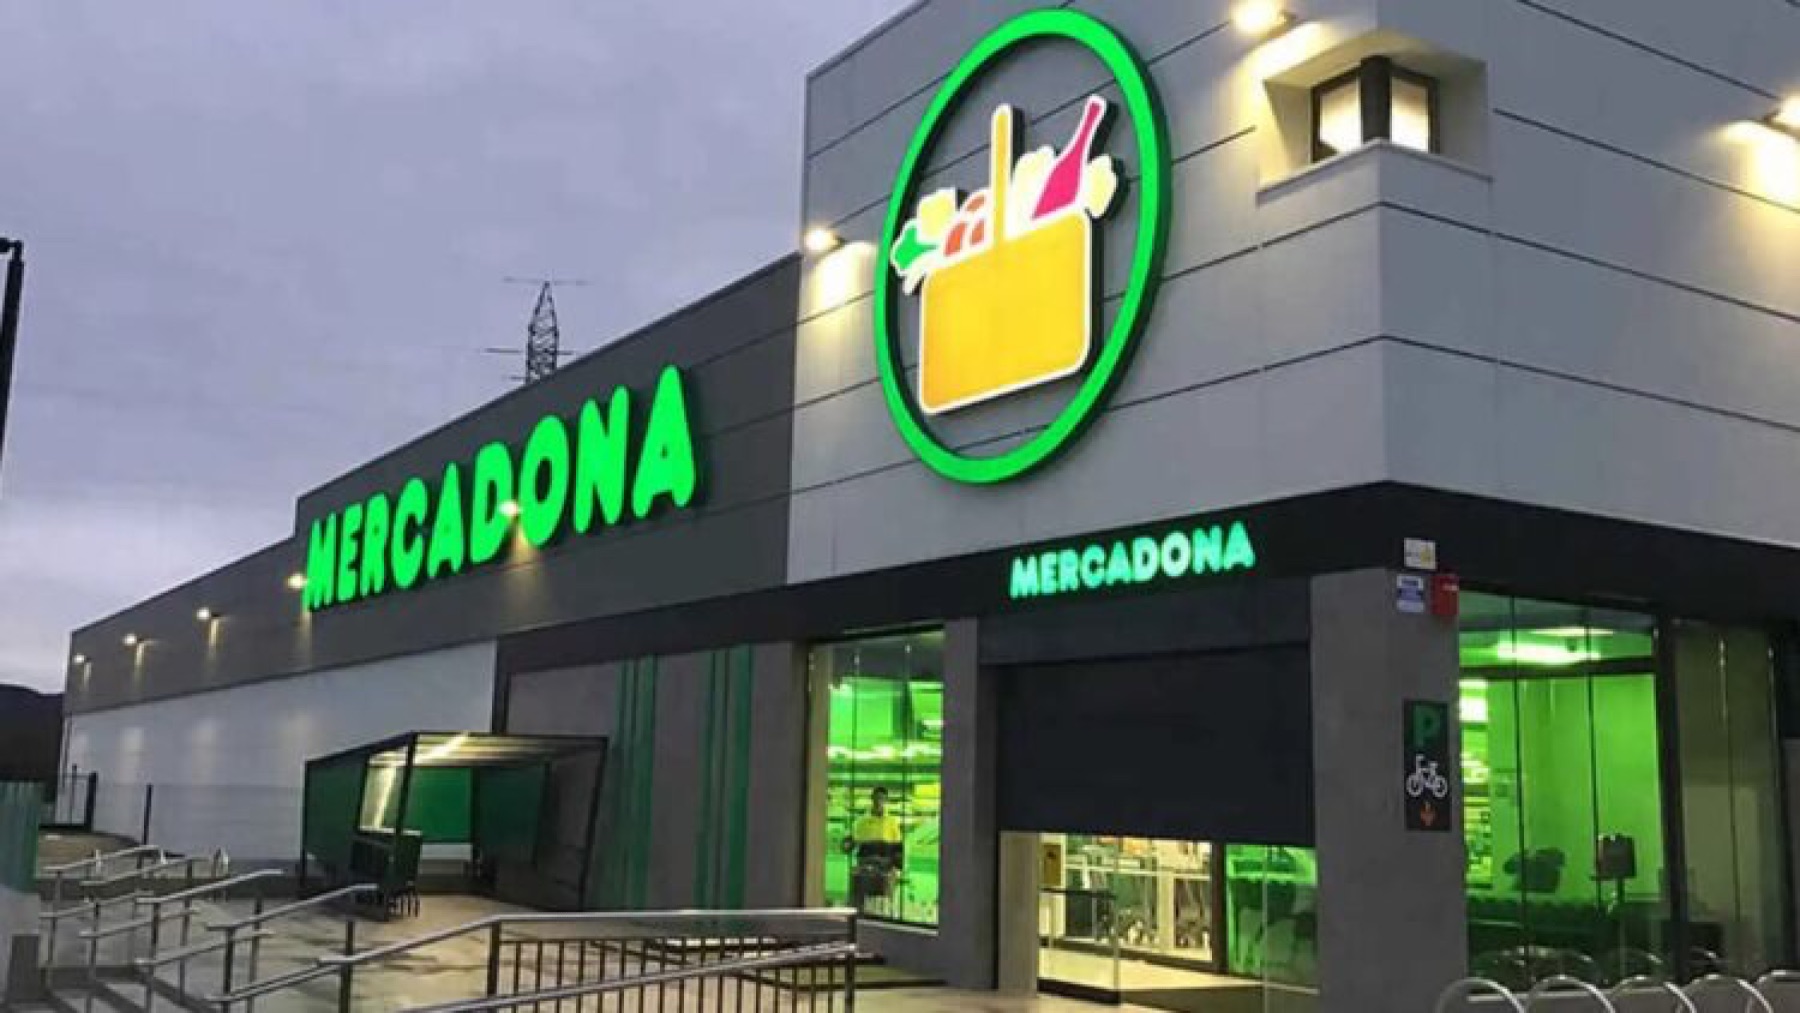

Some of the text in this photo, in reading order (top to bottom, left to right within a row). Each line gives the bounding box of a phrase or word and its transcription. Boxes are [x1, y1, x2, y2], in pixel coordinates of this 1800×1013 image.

[303, 365, 695, 611] MERCADONA
[1010, 521, 1256, 599] MERCADONA
[1413, 705, 1441, 748] P
